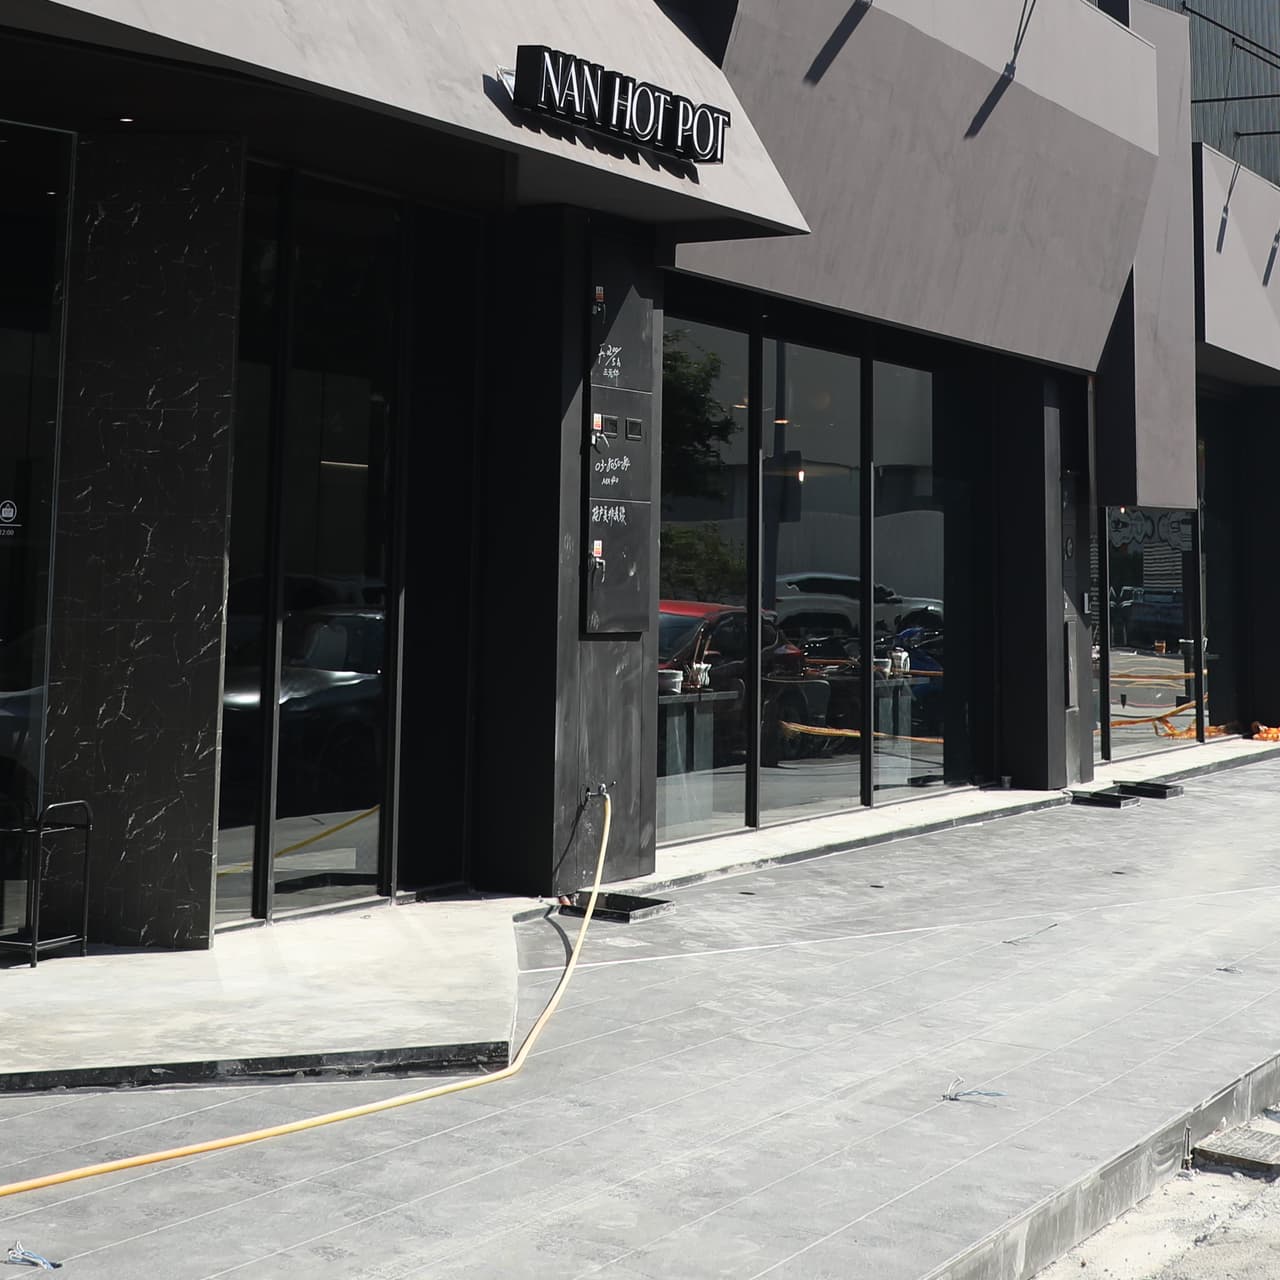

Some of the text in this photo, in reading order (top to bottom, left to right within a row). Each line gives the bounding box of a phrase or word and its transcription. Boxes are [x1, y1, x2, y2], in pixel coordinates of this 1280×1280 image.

[538, 51, 732, 160] NAN HOT POT
